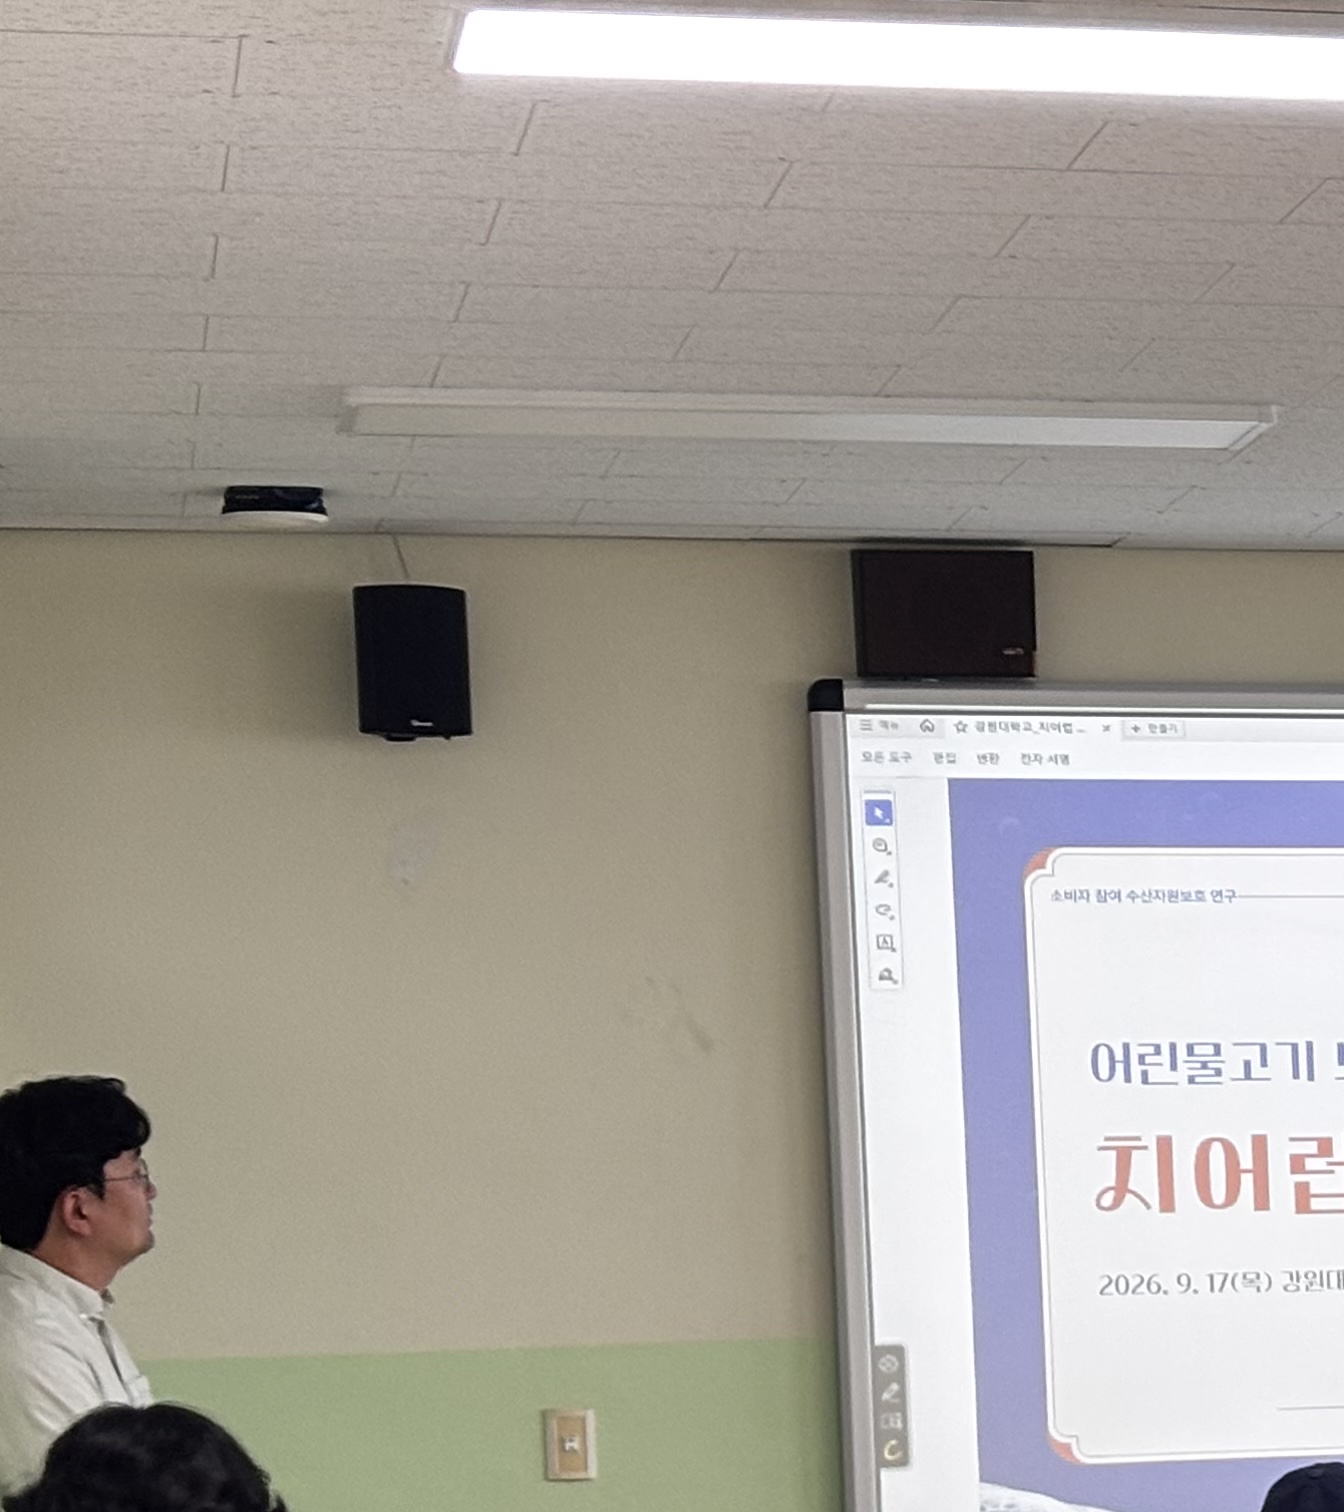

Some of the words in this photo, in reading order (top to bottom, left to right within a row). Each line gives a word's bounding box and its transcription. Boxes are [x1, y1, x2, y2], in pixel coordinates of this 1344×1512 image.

[888, 752, 912, 764] 도구
[1051, 889, 1091, 904] 소비자
[1095, 889, 1122, 904] 참여
[1125, 889, 1207, 904] 수산자원보호
[1209, 889, 1238, 904] 연구
[1090, 1040, 1316, 1086] 어린물고기
[1098, 1273, 1169, 1296] 2026.
[1176, 1272, 1199, 1295] 9.
[1207, 1271, 1273, 1294] 17(목)
